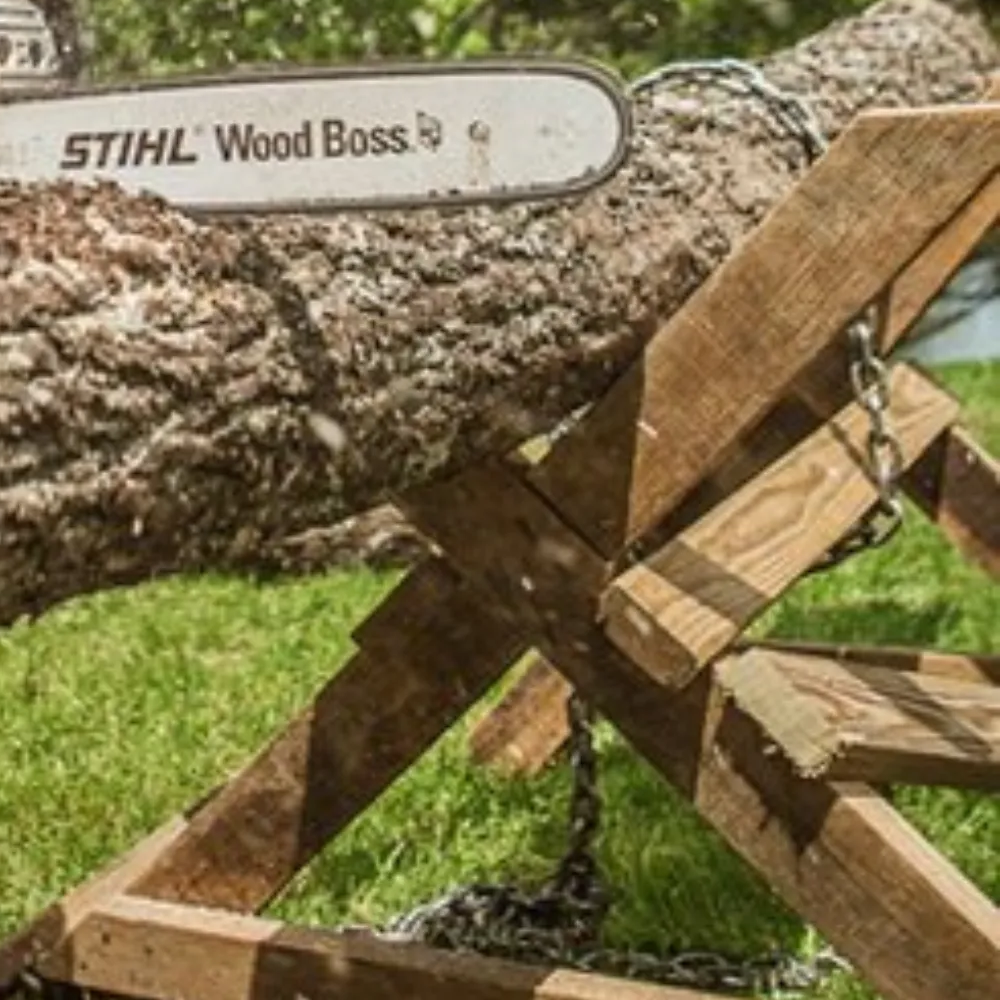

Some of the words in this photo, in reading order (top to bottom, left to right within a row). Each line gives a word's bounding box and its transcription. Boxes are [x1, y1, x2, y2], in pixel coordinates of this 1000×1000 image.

[60, 128, 197, 169] STIHL
[215, 119, 312, 162] Wood
[322, 119, 410, 158] Boss
